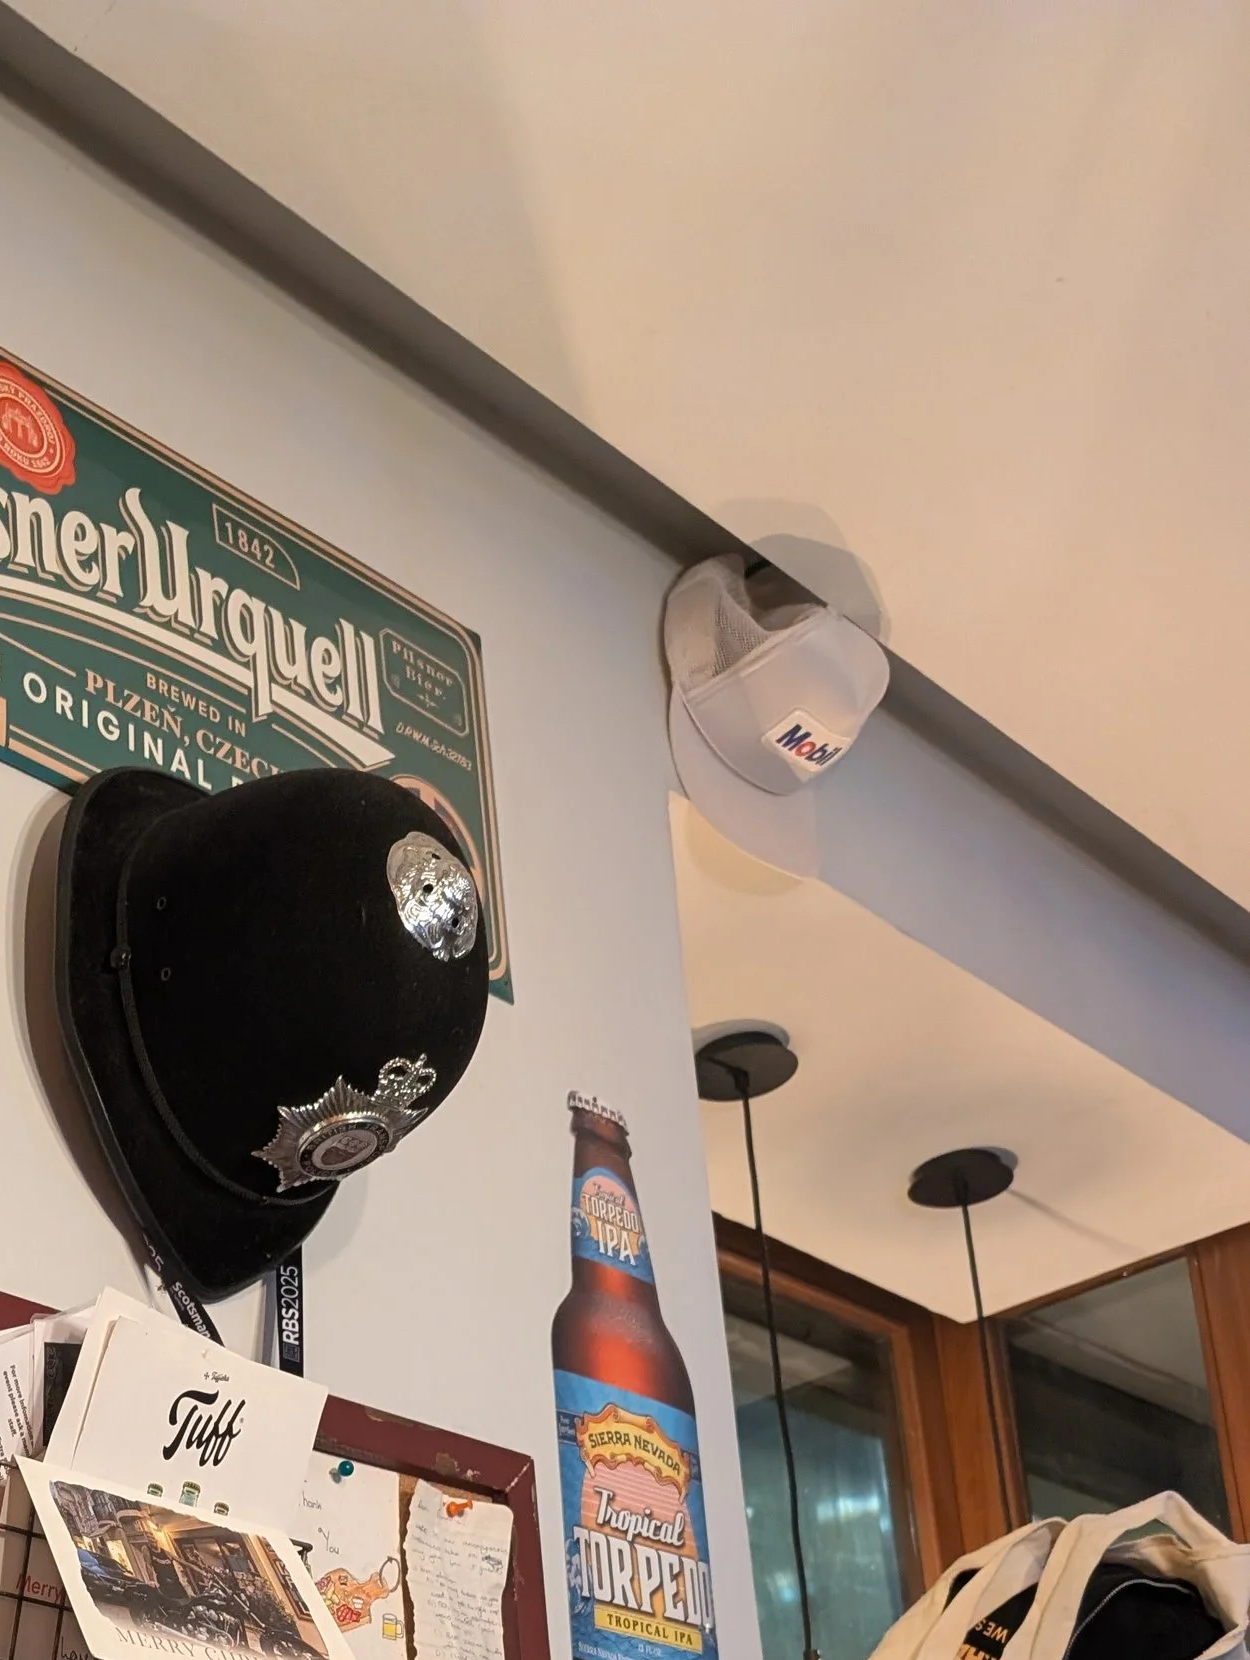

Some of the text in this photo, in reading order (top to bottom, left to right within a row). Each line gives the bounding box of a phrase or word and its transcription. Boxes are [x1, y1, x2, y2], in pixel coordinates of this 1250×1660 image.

[225, 520, 275, 570] 1842
[119, 487, 385, 738] Urquell
[146, 672, 247, 738] BREWED IN
[22, 672, 212, 791] ORIGINAL
[196, 728, 284, 778] CZEC
[775, 724, 842, 766] Mobil
[582, 1193, 640, 1233] TORPEDO
[596, 1220, 637, 1266] IPA
[280, 1266, 300, 1346] RBS2025
[162, 1389, 246, 1467] Tuff
[588, 1430, 681, 1476] SIERRA NEVADA
[594, 1486, 685, 1547] Tropical
[573, 1525, 715, 1630] TORPEDO
[114, 1626, 196, 1658] MERRY
[607, 1613, 693, 1646] TROPICAL IPA
